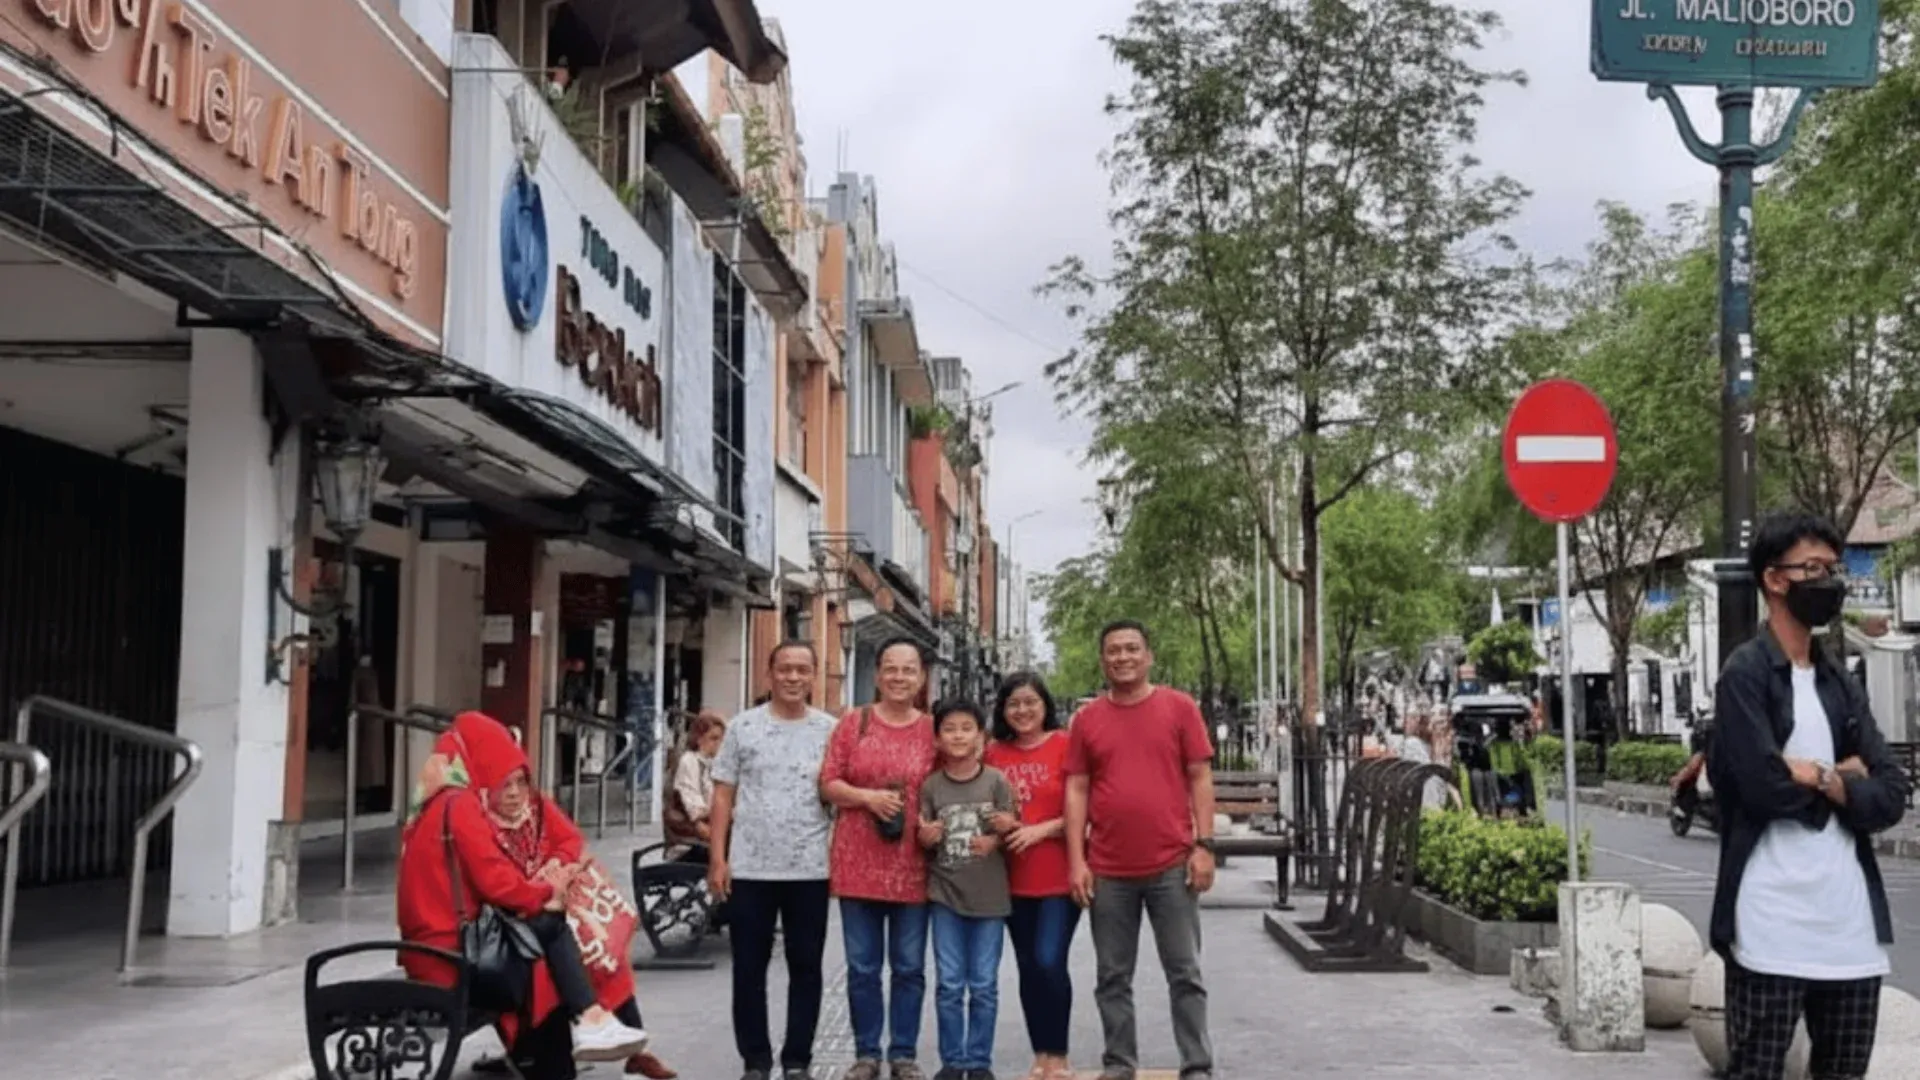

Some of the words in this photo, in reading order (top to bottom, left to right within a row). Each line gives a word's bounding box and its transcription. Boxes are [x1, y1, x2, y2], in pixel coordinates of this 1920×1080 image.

[1620, 0, 1656, 19] JL.
[1676, 0, 1856, 26] MALIOBORO
[168, 2, 263, 168] Tek
[264, 94, 334, 219] An
[336, 141, 419, 300] Tong
